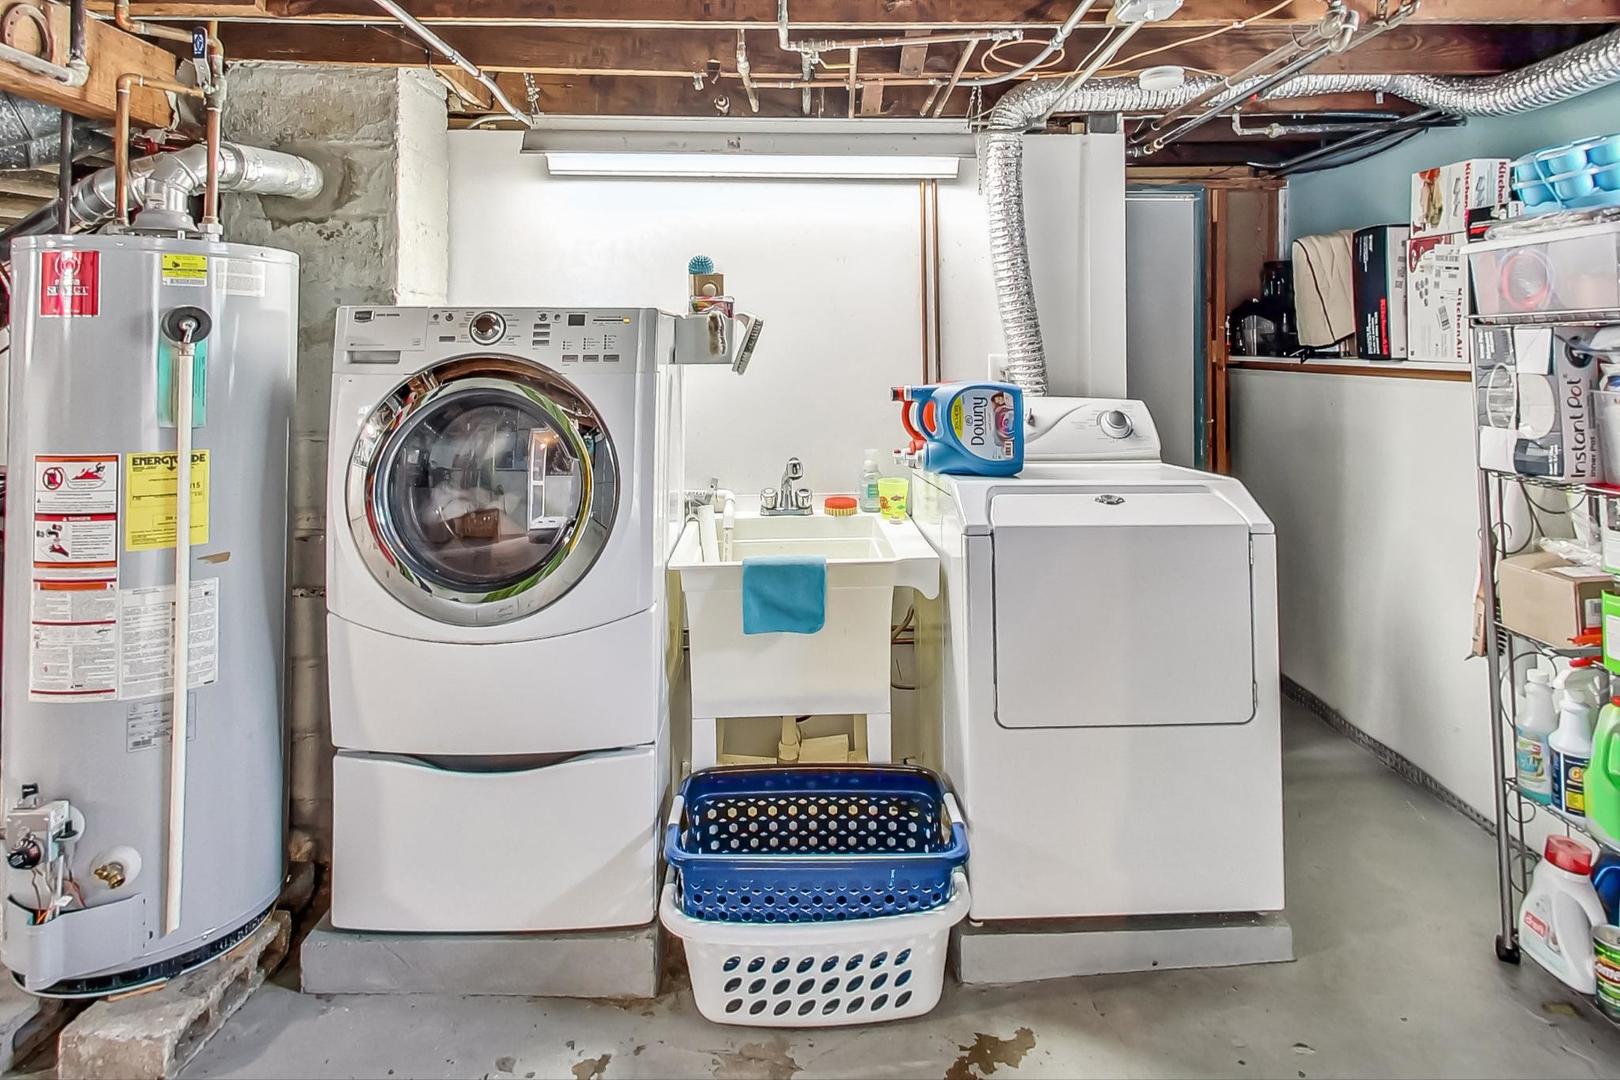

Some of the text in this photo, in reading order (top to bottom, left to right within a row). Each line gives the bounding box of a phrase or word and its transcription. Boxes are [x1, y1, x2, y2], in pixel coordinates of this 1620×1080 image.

[970, 396, 988, 446] Downy
[1566, 377, 1587, 478] Instant Pot
[132, 453, 206, 469] ENERGYDE
